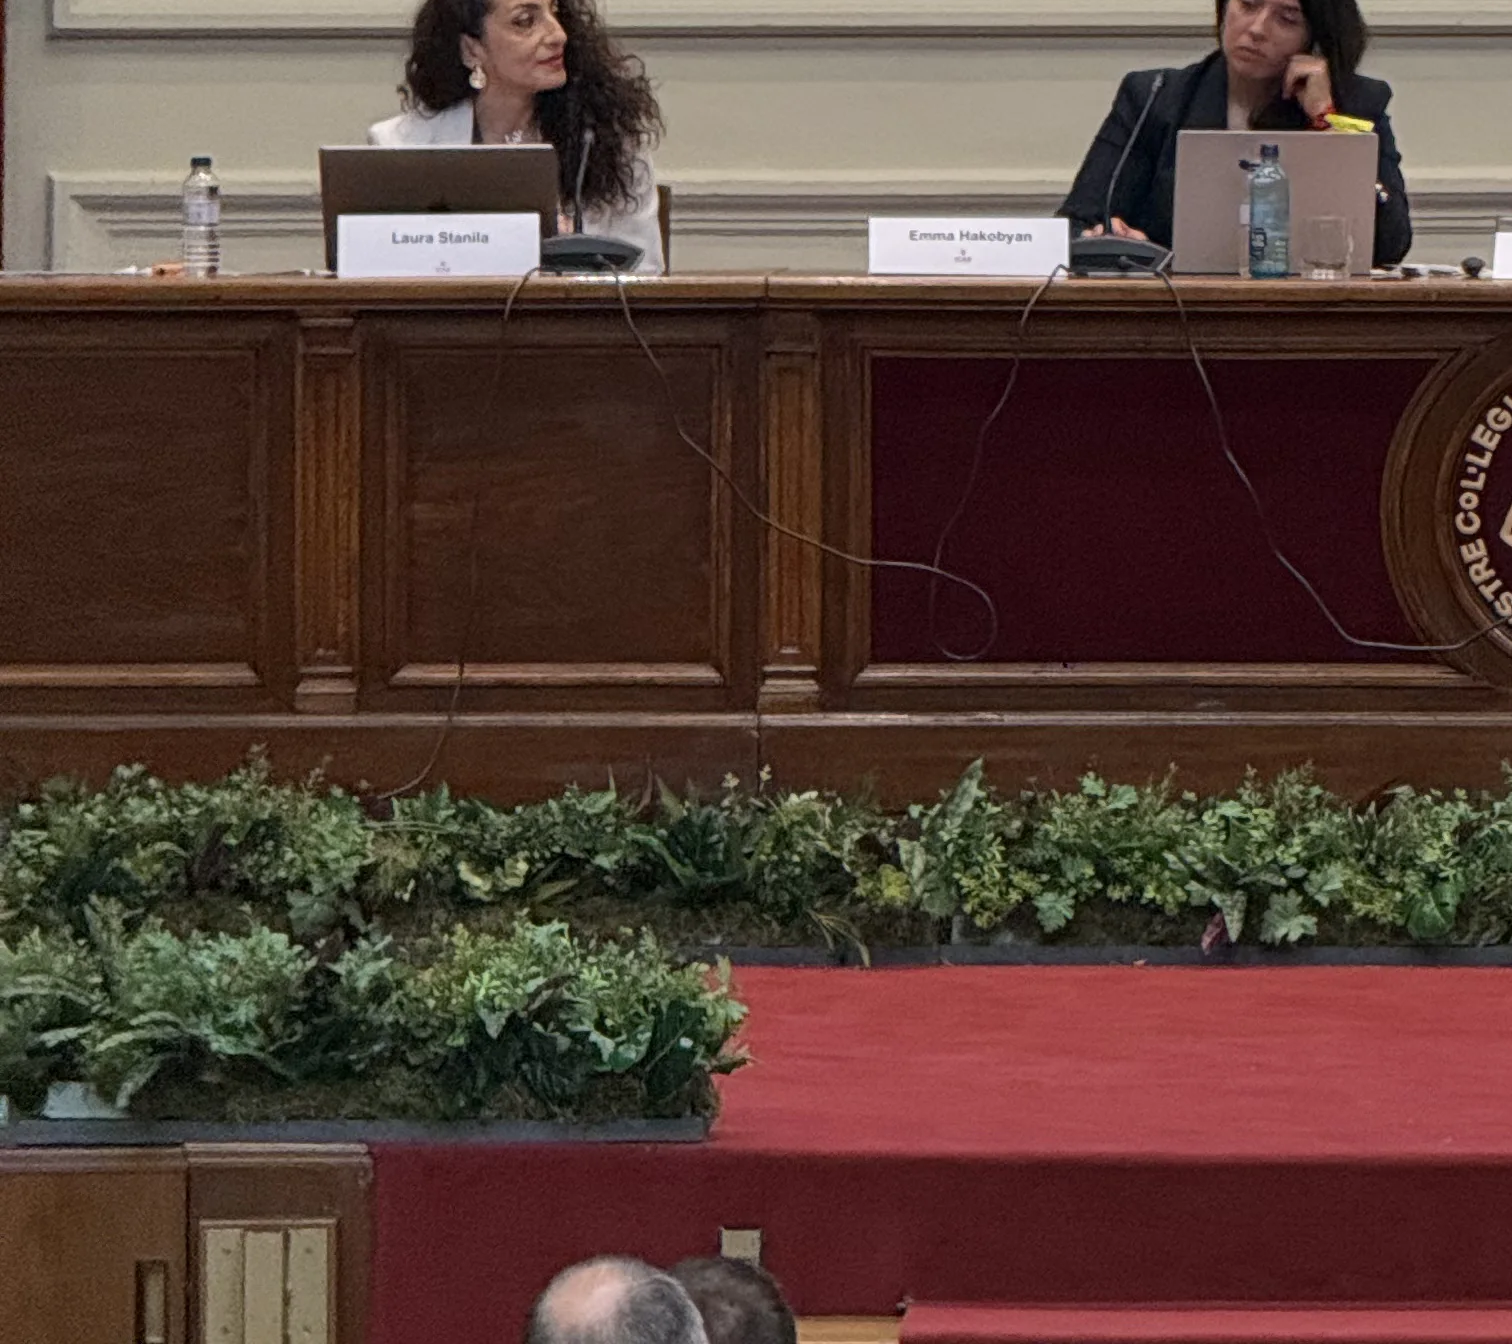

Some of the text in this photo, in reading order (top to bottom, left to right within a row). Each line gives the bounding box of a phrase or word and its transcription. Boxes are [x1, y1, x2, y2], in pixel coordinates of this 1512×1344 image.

[391, 231, 490, 245] Laura Stanila
[909, 229, 1033, 245] Emma Hakobyan
